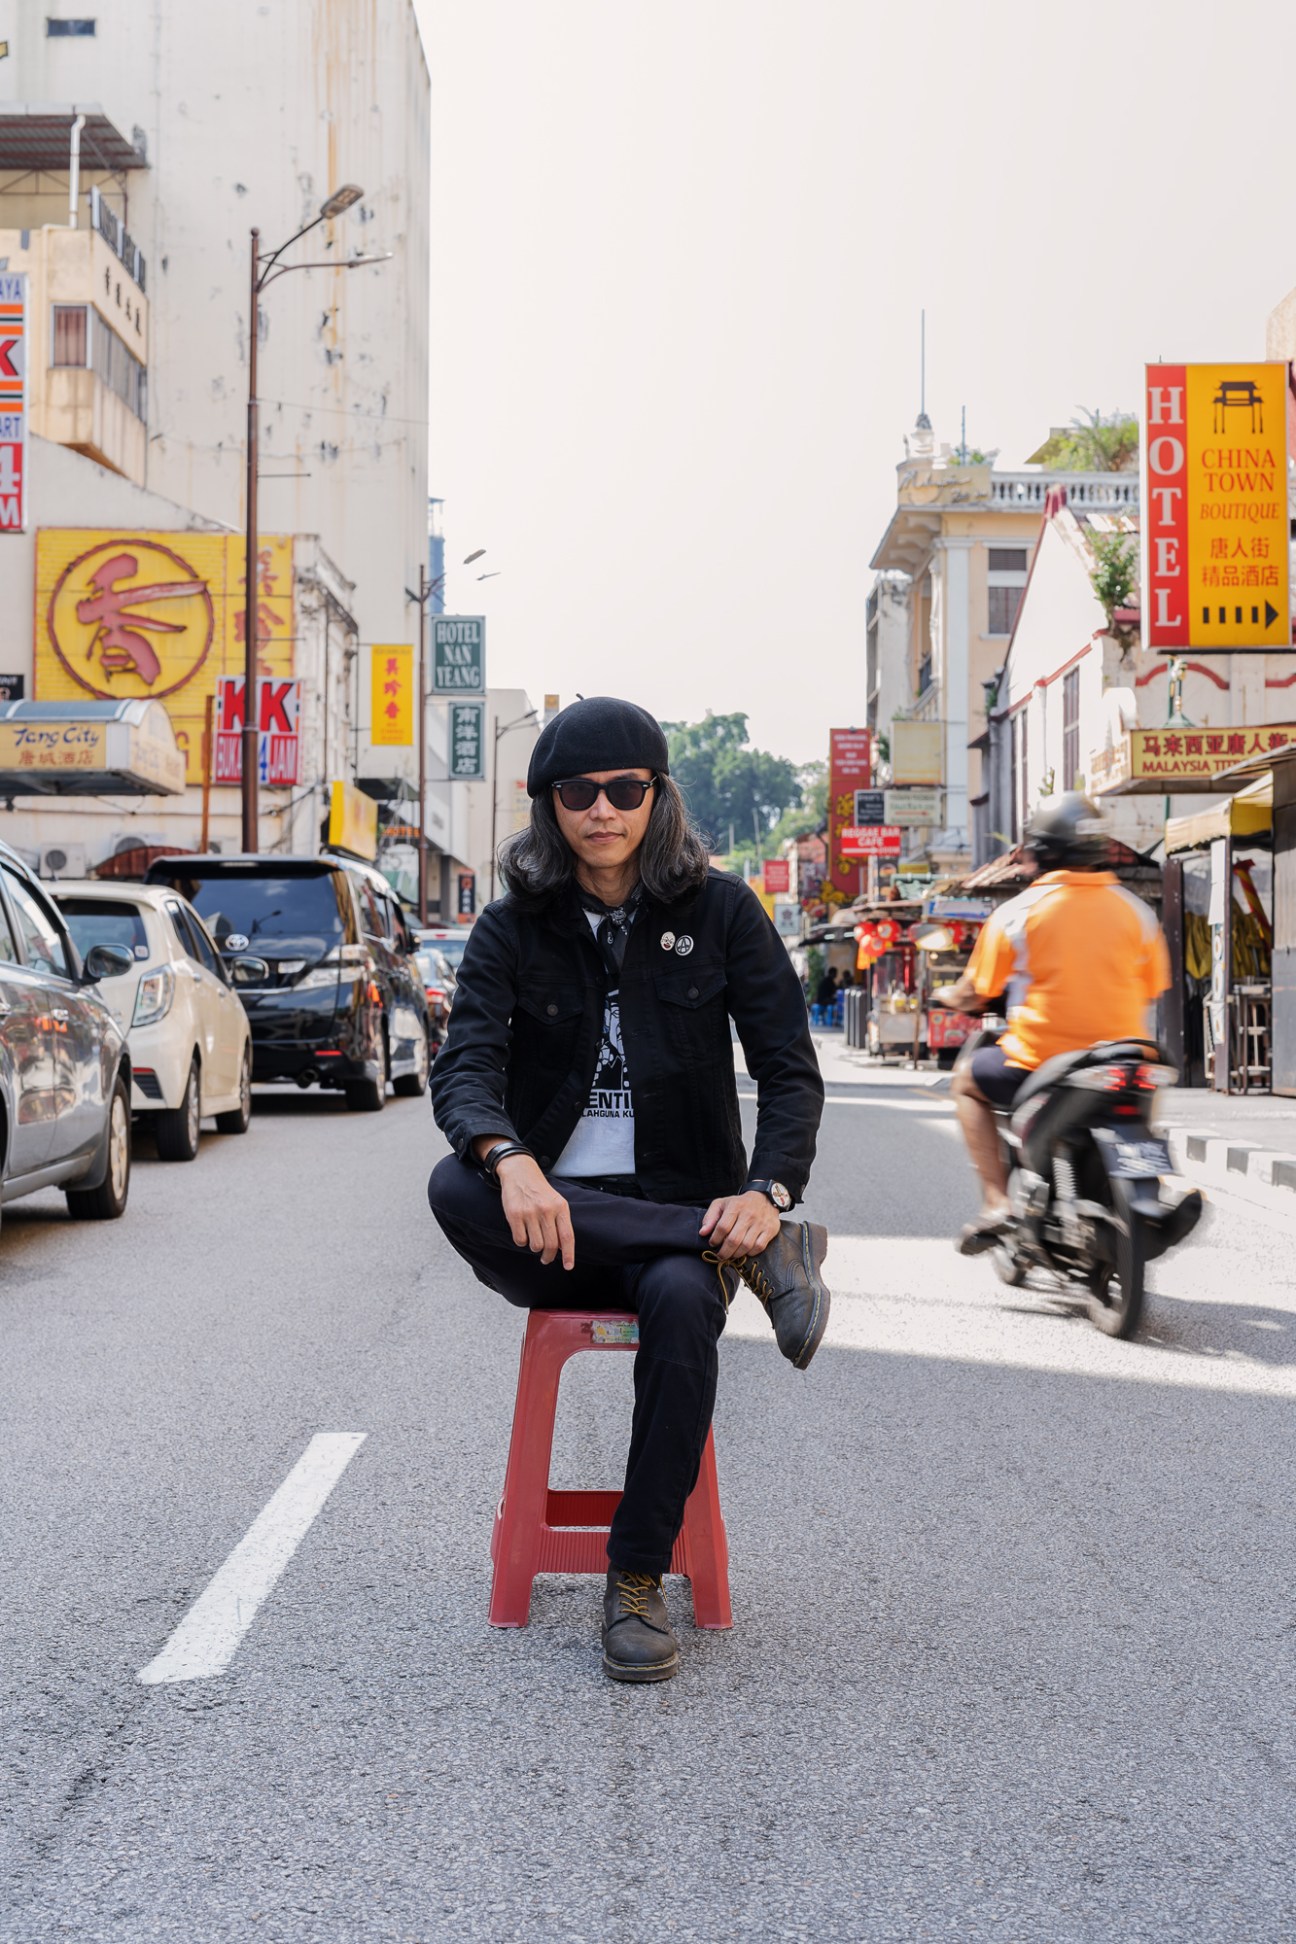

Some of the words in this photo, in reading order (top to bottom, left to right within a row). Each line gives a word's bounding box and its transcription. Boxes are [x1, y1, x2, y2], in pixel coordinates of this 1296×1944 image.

[1201, 448, 1276, 469] CHINA
[1203, 472, 1275, 492] TOWN
[1149, 386, 1185, 627] HOTEL
[1200, 502, 1280, 524] BOUTIQUE
[1210, 537, 1270, 559] 唐人街
[1202, 565, 1280, 587] 精品酒店
[436, 622, 480, 643] HOTEL
[443, 645, 472, 665] NAN
[436, 666, 480, 687] YEANG
[63, 726, 100, 748] City
[1143, 732, 1296, 757] 马来西亚唐人街
[1142, 760, 1211, 773] MALAYSIA
